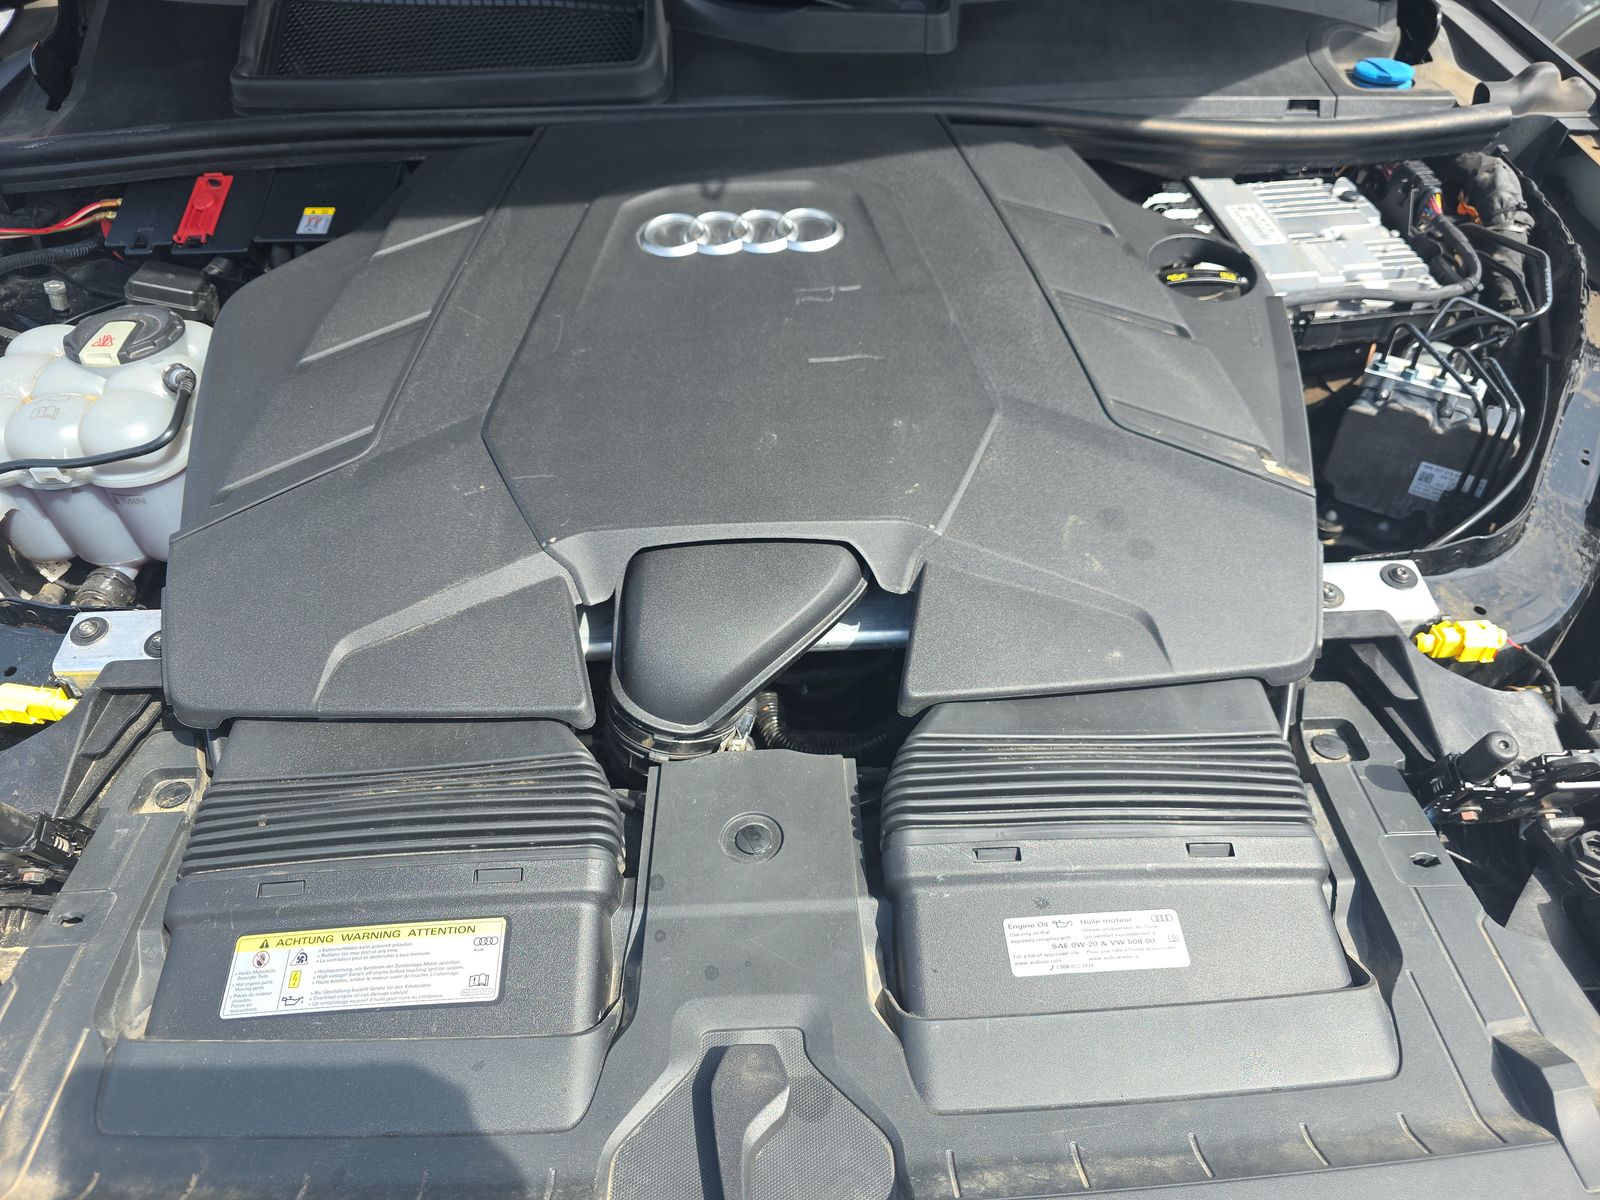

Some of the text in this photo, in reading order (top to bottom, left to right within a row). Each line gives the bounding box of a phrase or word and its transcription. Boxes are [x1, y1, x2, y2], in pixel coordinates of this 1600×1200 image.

[275, 925, 476, 947] ACHTUNG WARNING ATTENTION
